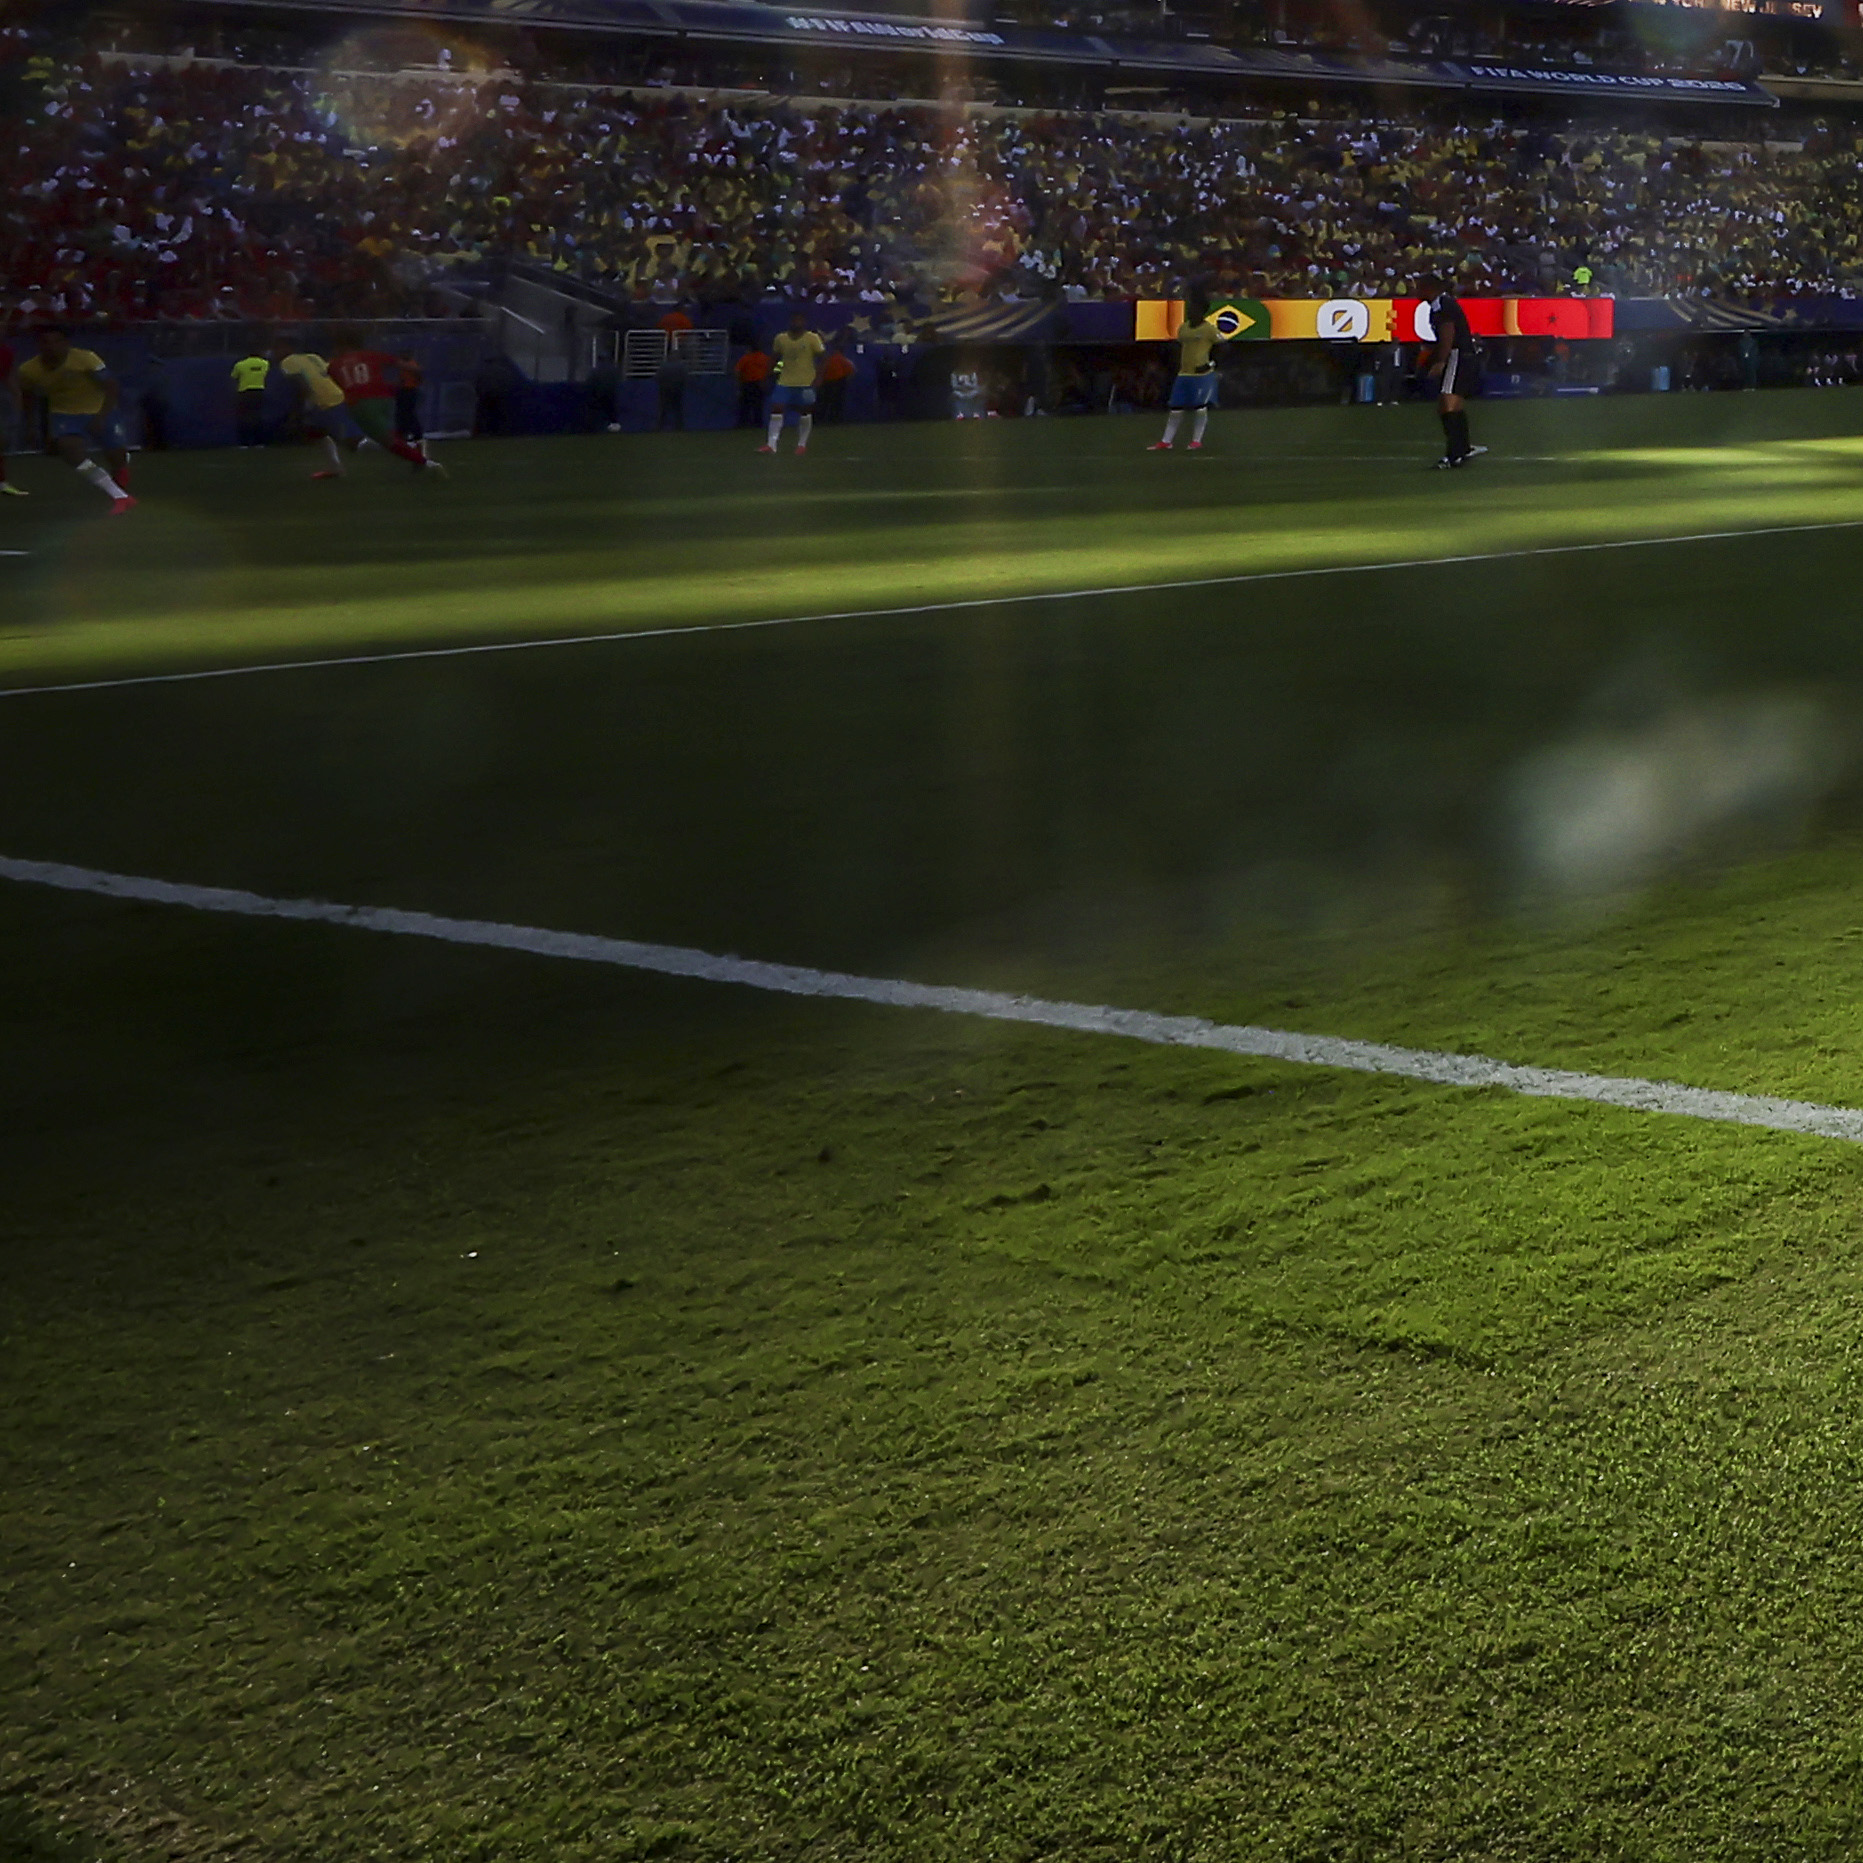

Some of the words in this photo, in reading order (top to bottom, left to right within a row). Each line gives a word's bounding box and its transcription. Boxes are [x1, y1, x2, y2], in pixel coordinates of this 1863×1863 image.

[1470, 65, 1528, 80] FIFA
[1533, 69, 1614, 85] WORLD
[1617, 74, 1665, 88] CUP
